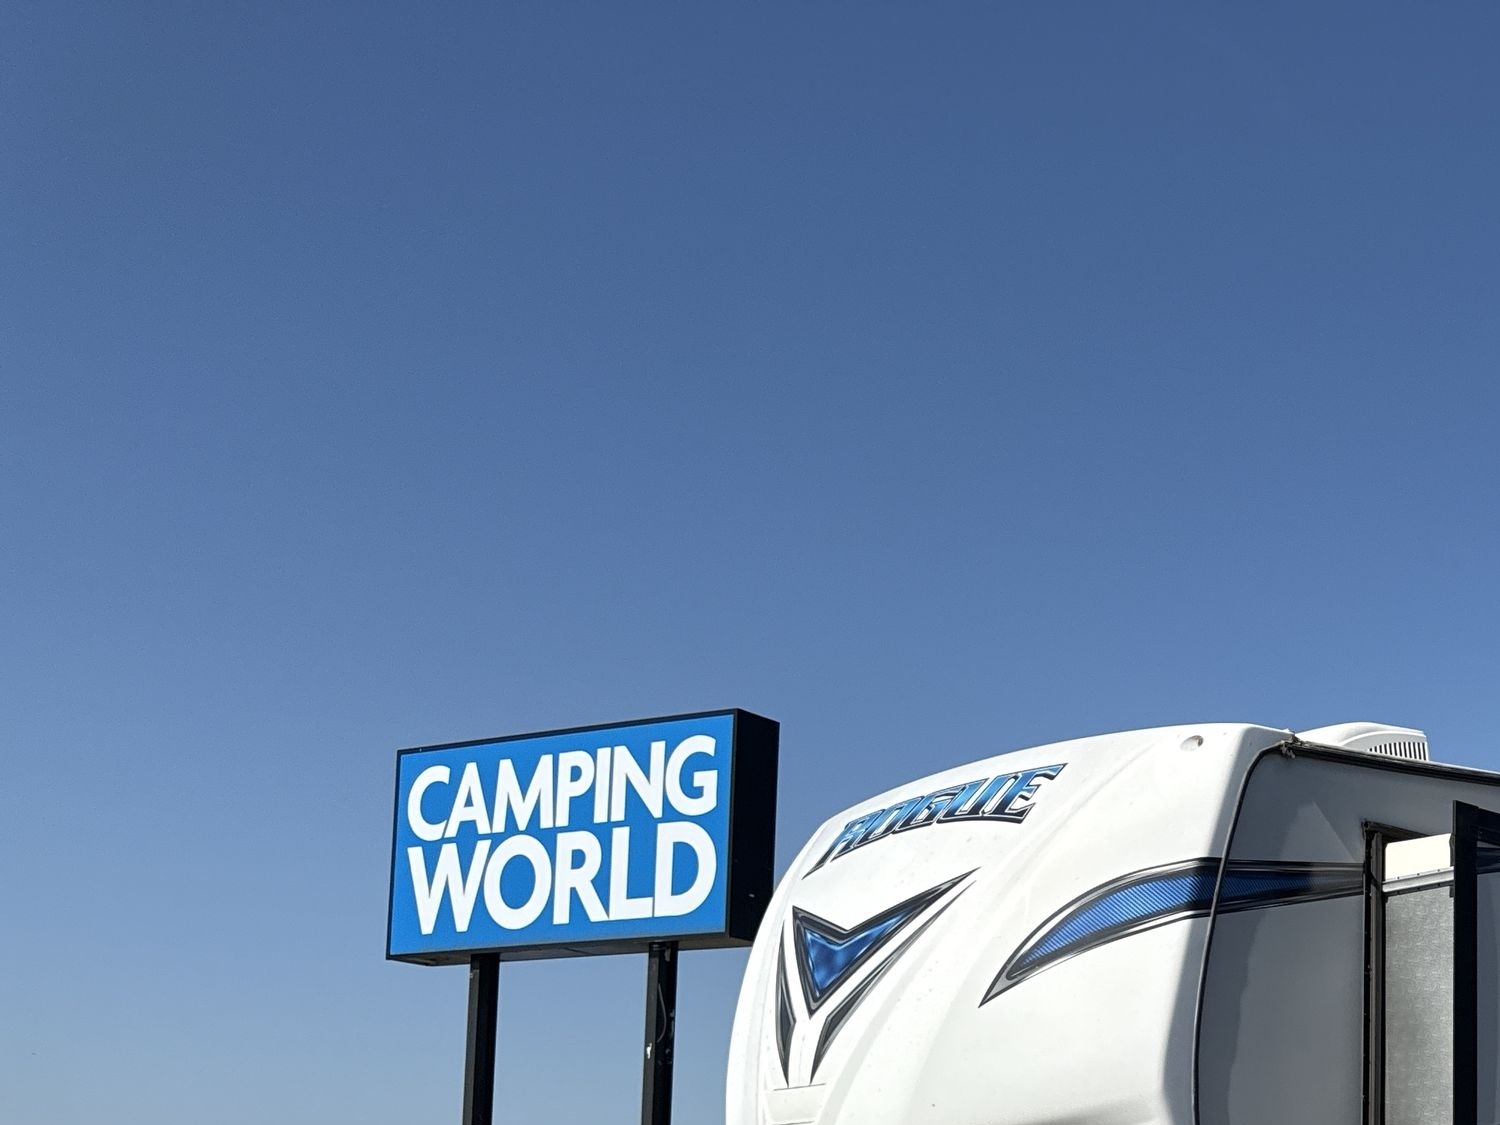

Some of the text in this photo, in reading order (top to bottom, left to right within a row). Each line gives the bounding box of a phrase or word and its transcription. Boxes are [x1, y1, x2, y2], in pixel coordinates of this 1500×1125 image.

[408, 735, 718, 841] CAMPING
[802, 763, 1068, 880] ROGUE
[408, 821, 717, 935] WORLD
